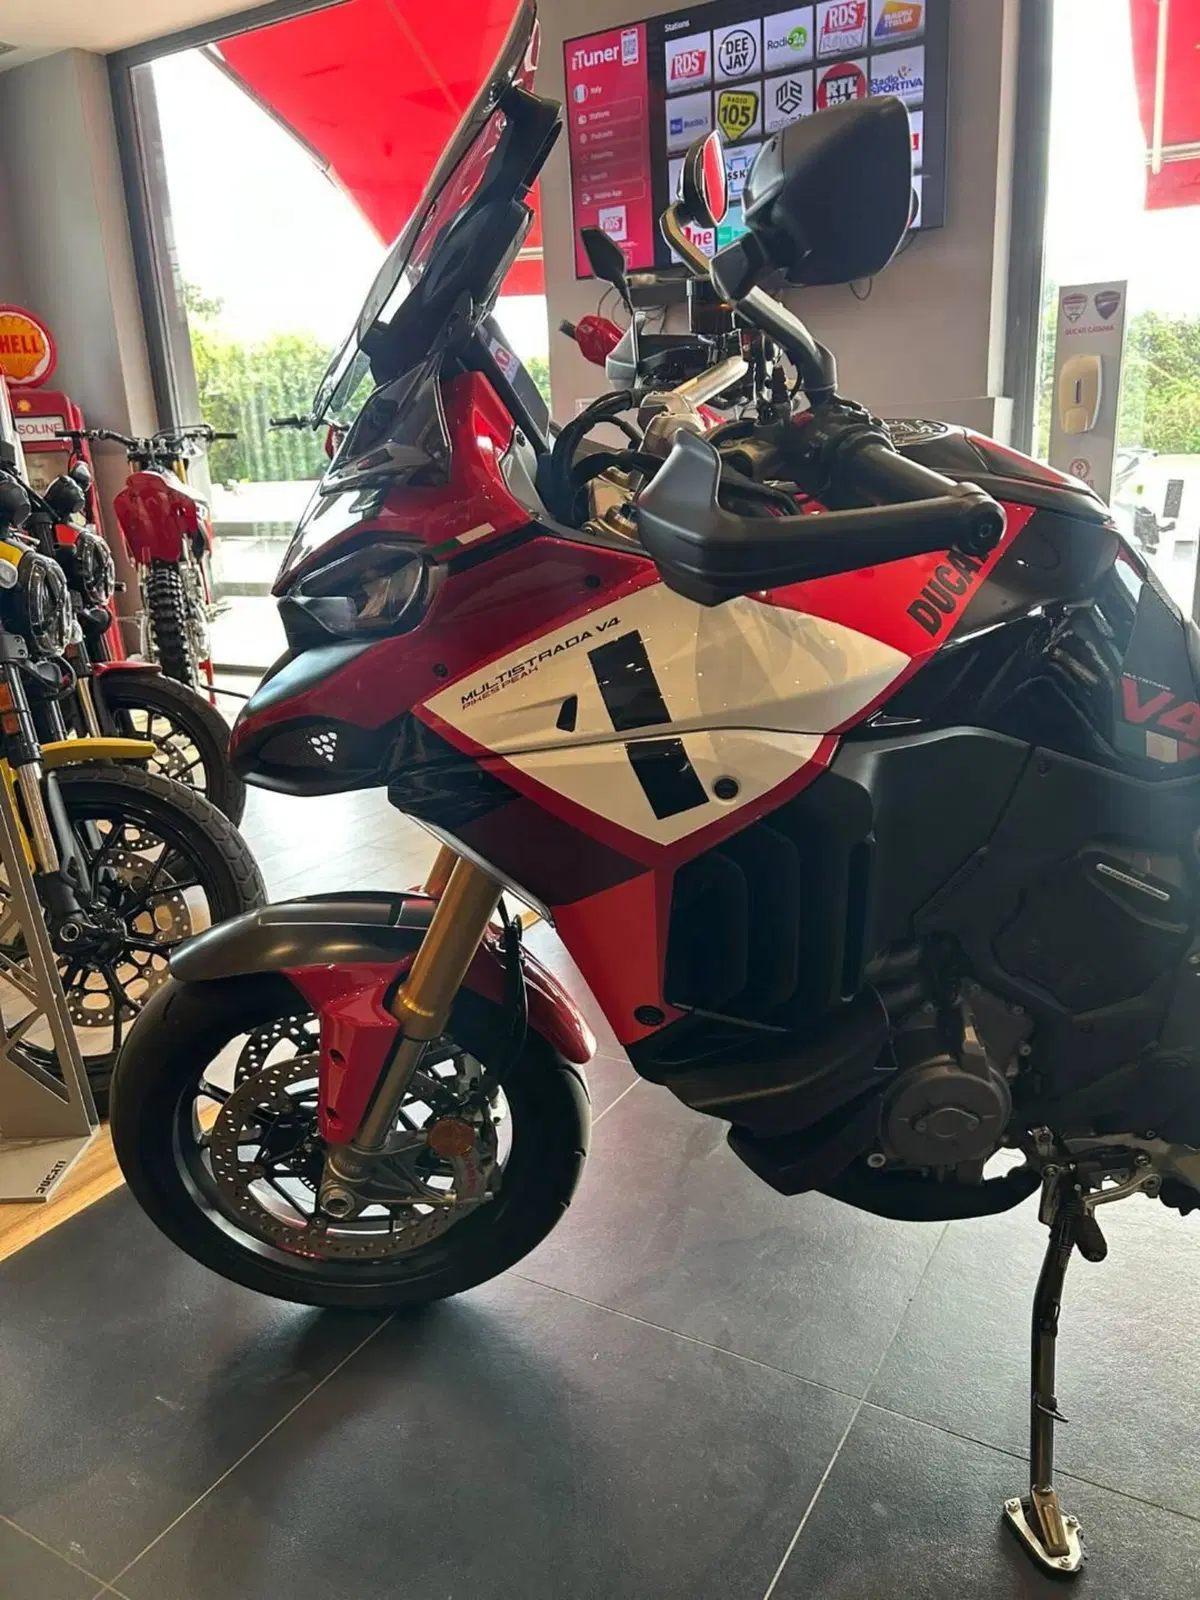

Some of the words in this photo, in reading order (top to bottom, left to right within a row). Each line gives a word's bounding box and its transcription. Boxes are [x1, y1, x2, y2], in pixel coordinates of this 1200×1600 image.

[664, 20, 690, 32] Stations
[829, 3, 857, 28] RDS
[726, 37, 749, 55] DEE
[674, 51, 700, 76] RDS
[726, 52, 749, 70] JAY
[871, 77, 923, 94] SPORTIVA
[872, 74, 899, 86] Radio
[721, 104, 751, 127] 105
[0, 334, 38, 354] HELL
[17, 422, 62, 435] SOLINE
[906, 547, 982, 638] DUCA
[460, 631, 594, 705] MULTISTRADA
[596, 616, 622, 633] V4
[1120, 676, 1200, 740] V4
[36, 1160, 67, 1194] DUCATI
